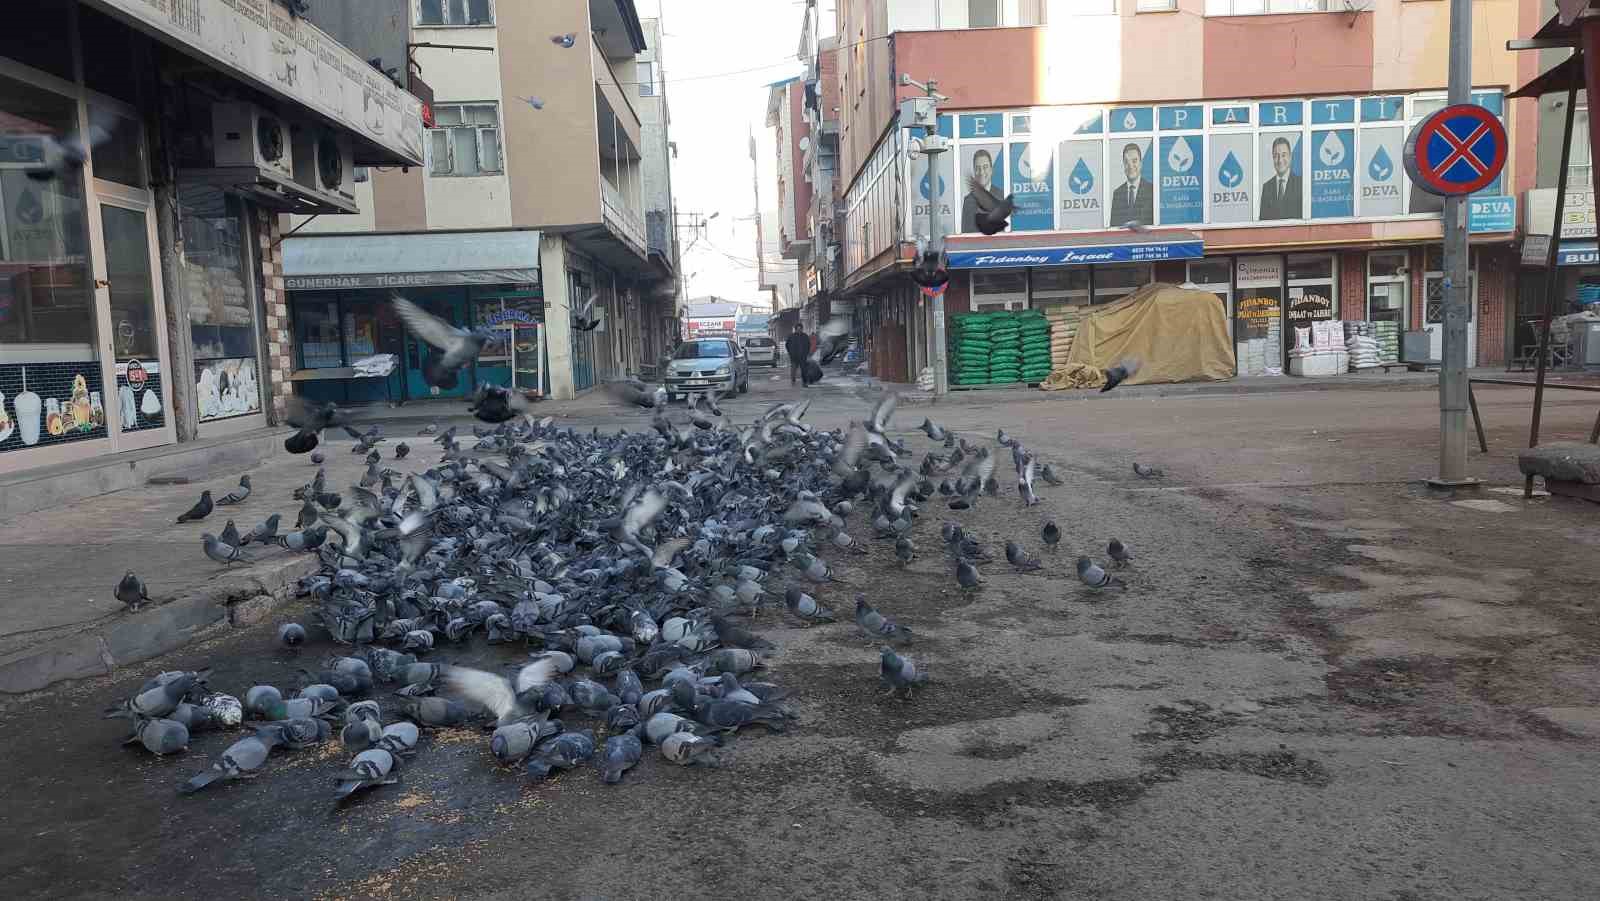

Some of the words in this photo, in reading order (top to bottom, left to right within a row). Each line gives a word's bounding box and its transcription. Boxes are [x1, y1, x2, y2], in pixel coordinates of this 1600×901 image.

[974, 117, 987, 135] E
[1175, 110, 1188, 127] P
[1225, 109, 1237, 122] A
[1273, 106, 1288, 123] R
[1326, 103, 1340, 120] T
[1314, 168, 1351, 181] DEVA
[1163, 175, 1200, 187] DEVA
[1013, 182, 1050, 193] DEVA
[1362, 185, 1399, 198] DEVA
[1213, 191, 1249, 203] DEVA
[1063, 198, 1100, 210] DEVA
[1471, 202, 1512, 214] DEVA
[975, 255, 1049, 266] Fidanboy
